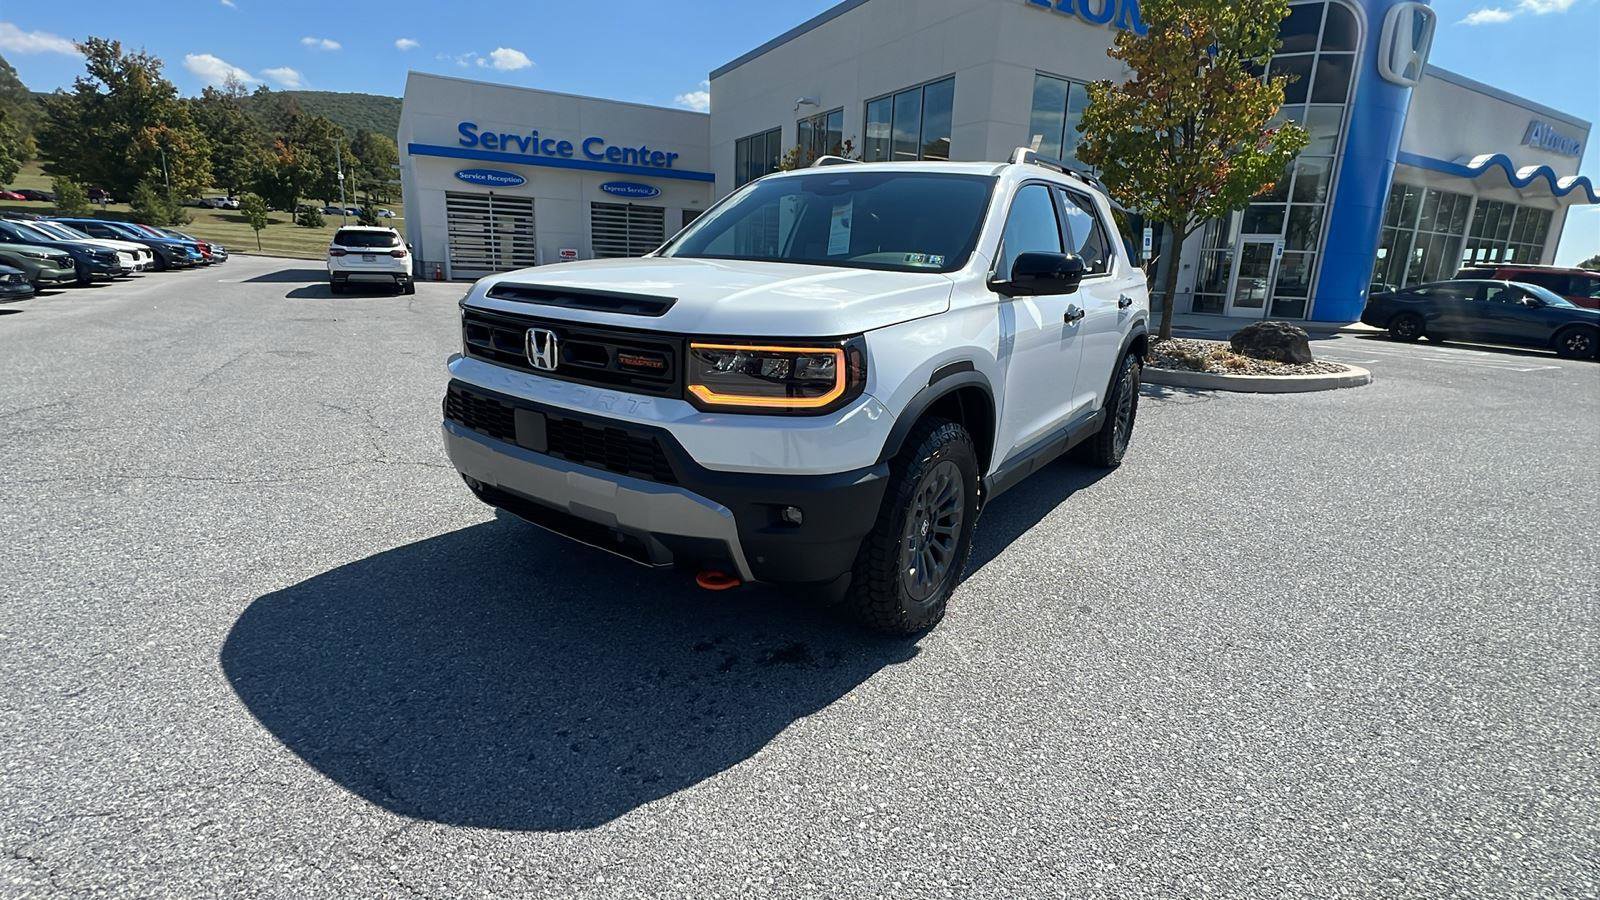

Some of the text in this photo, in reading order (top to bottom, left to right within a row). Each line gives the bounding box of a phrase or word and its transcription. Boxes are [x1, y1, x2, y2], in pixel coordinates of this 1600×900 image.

[457, 121, 679, 168] Service Center
[459, 171, 523, 184] Service Reception
[603, 184, 627, 193] Express
